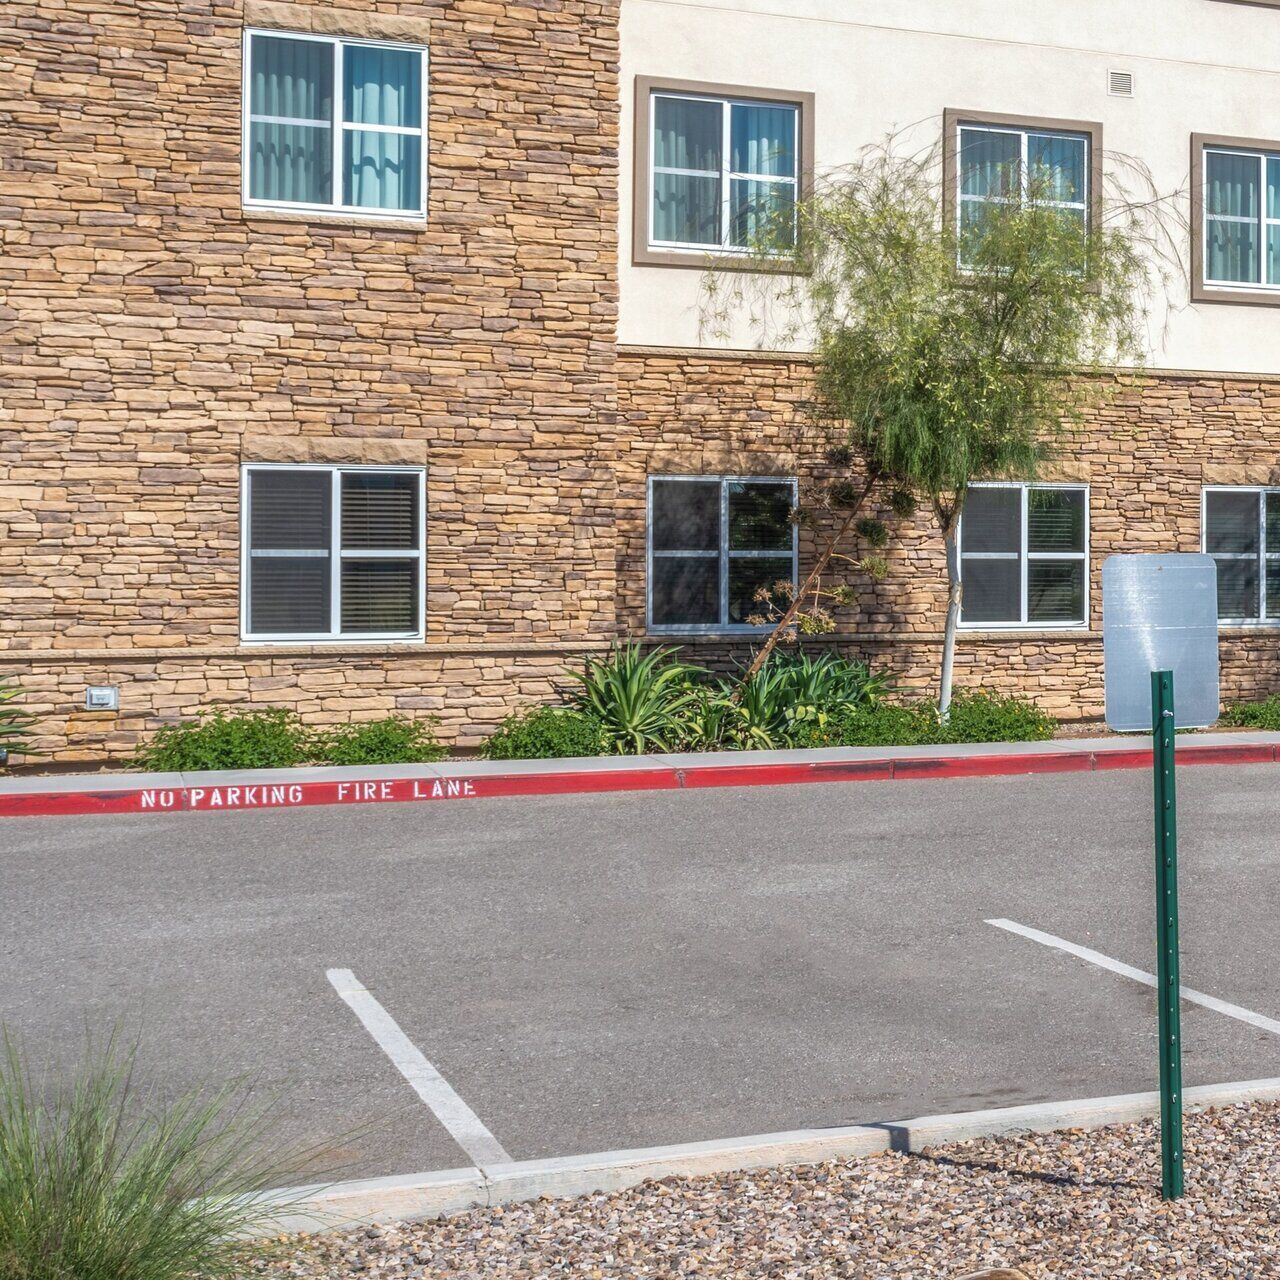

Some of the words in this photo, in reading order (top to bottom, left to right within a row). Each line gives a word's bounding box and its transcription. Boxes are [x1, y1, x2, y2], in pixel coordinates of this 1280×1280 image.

[141, 790, 174, 808] NO
[191, 785, 303, 806] PARKING
[338, 782, 394, 800] FIRE
[413, 779, 476, 798] LANE
